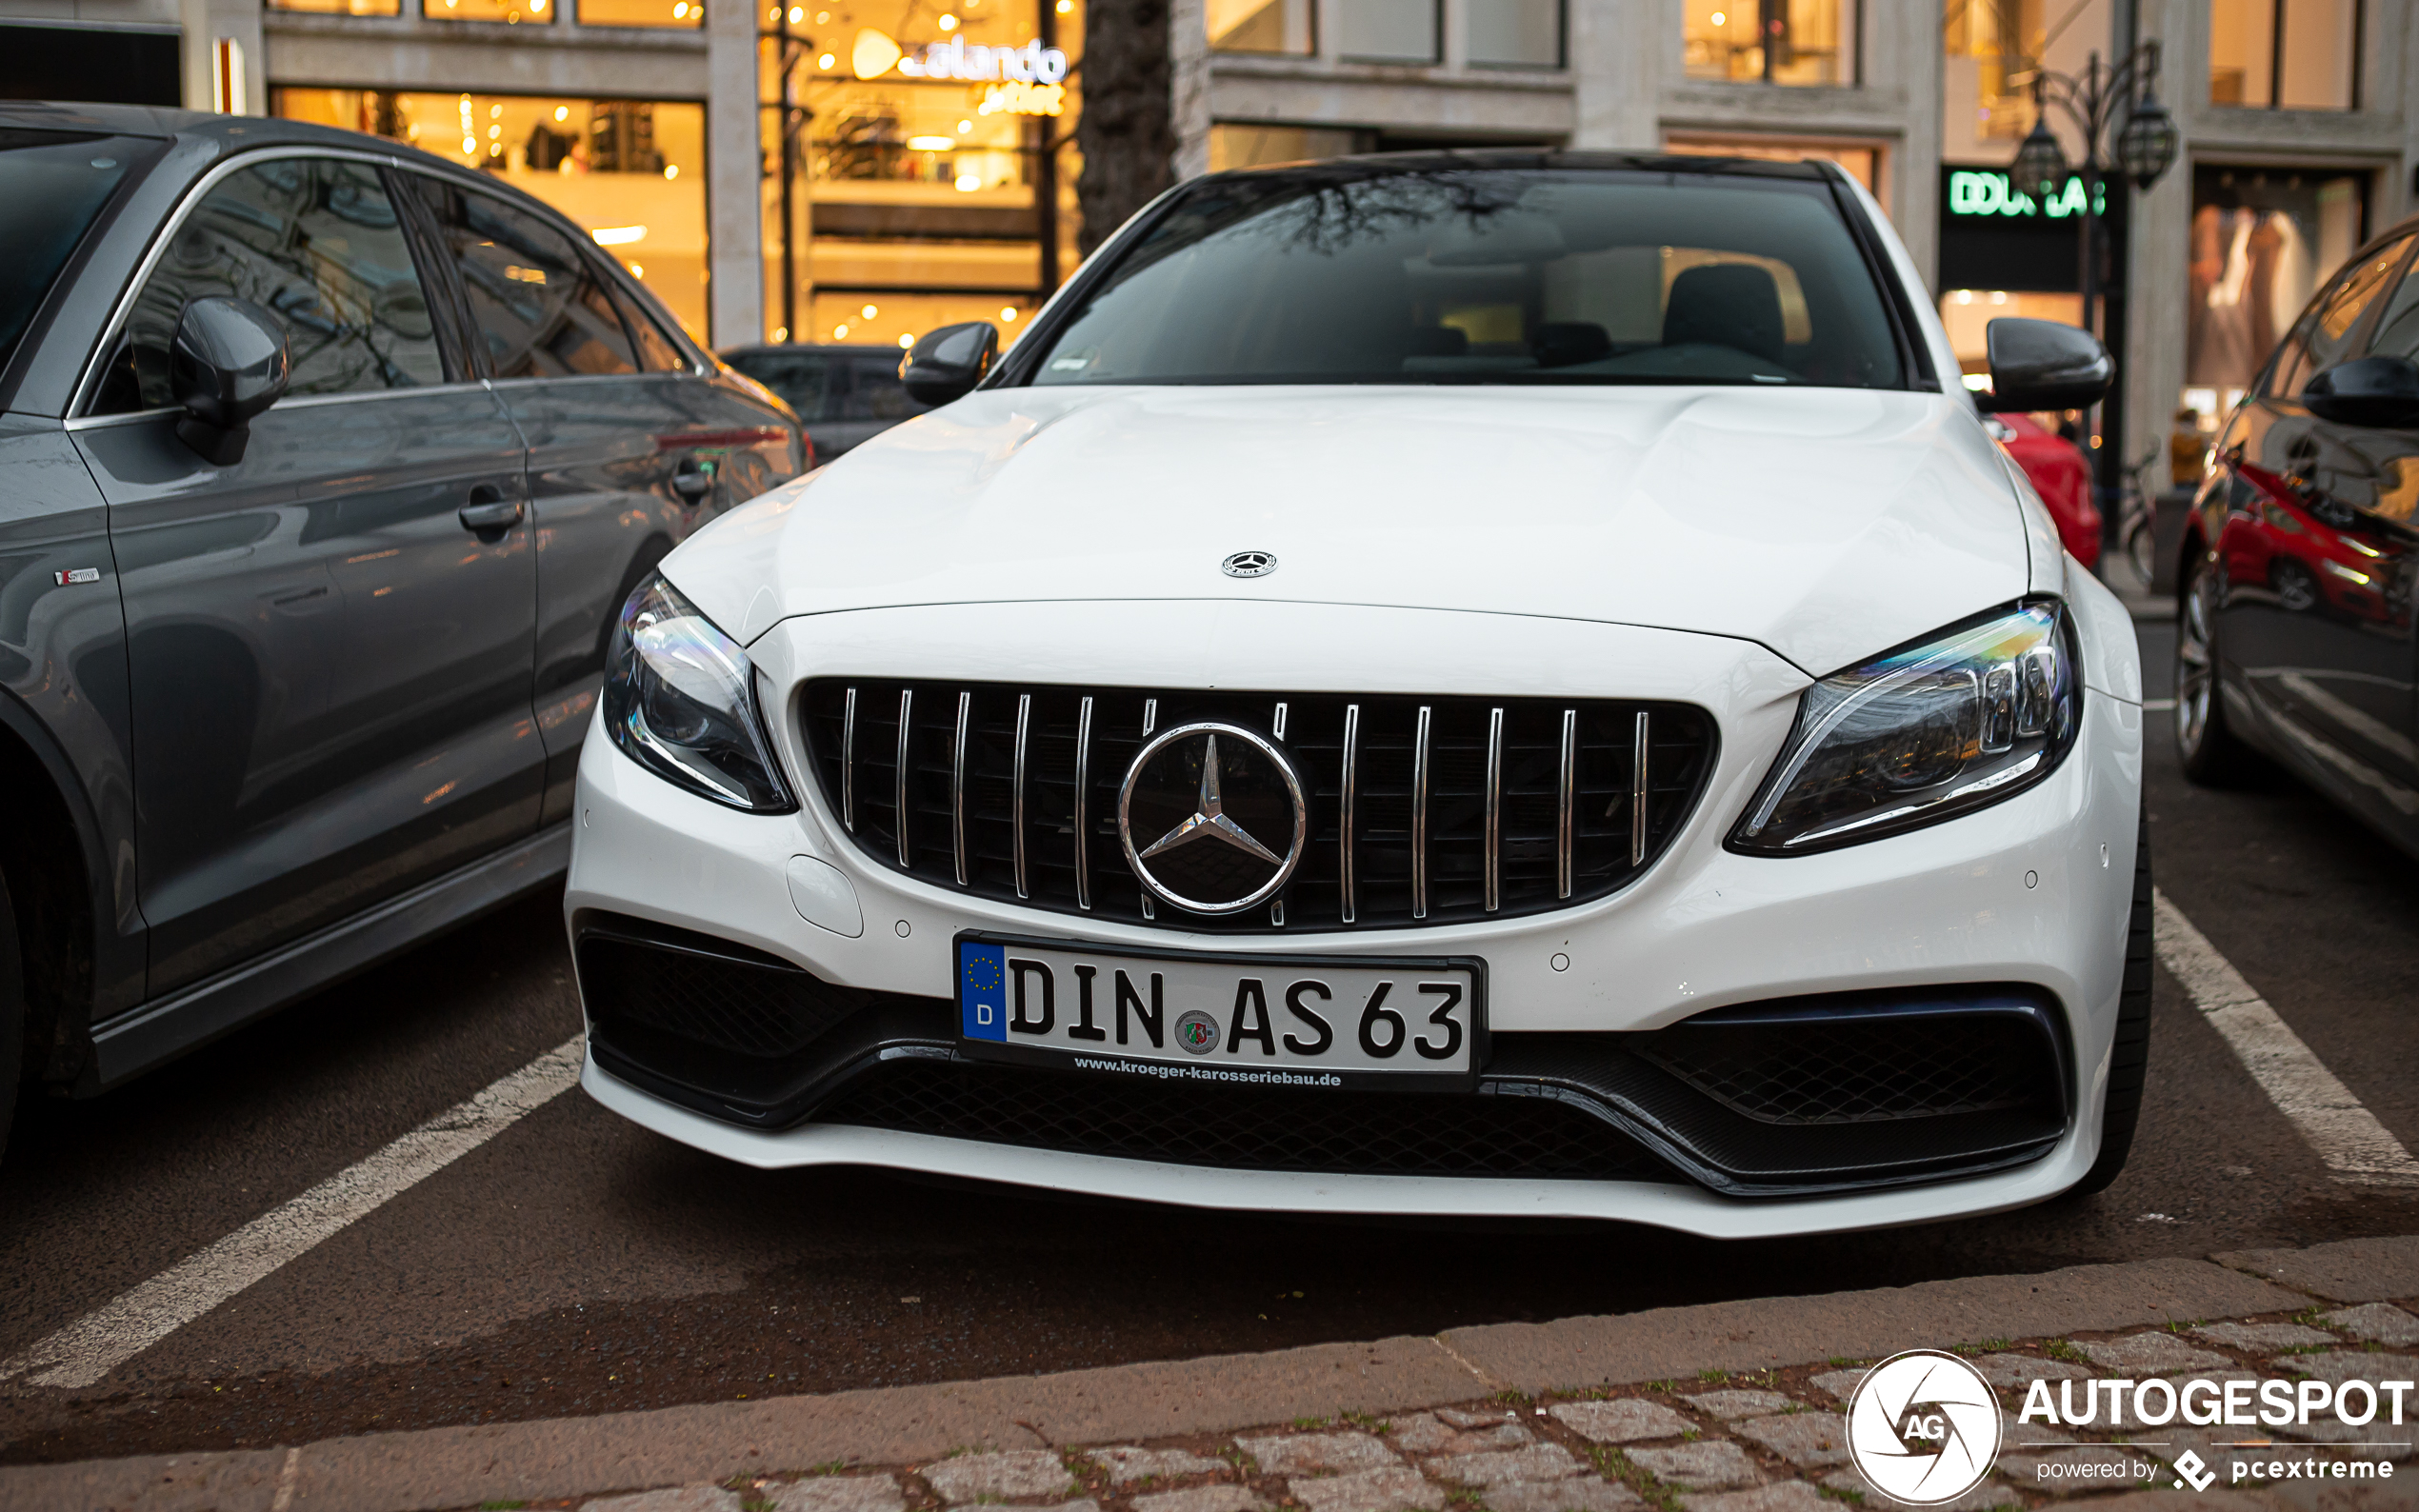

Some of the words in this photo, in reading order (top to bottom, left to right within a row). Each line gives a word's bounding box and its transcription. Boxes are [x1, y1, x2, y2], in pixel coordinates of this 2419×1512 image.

[977, 1004, 992, 1025] D
[1008, 958, 1165, 1049] DIN
[1226, 978, 1333, 1057] AS
[1358, 982, 1463, 1061] 63
[1074, 1057, 1342, 1086] www.kroeger-karosseriebau.de
